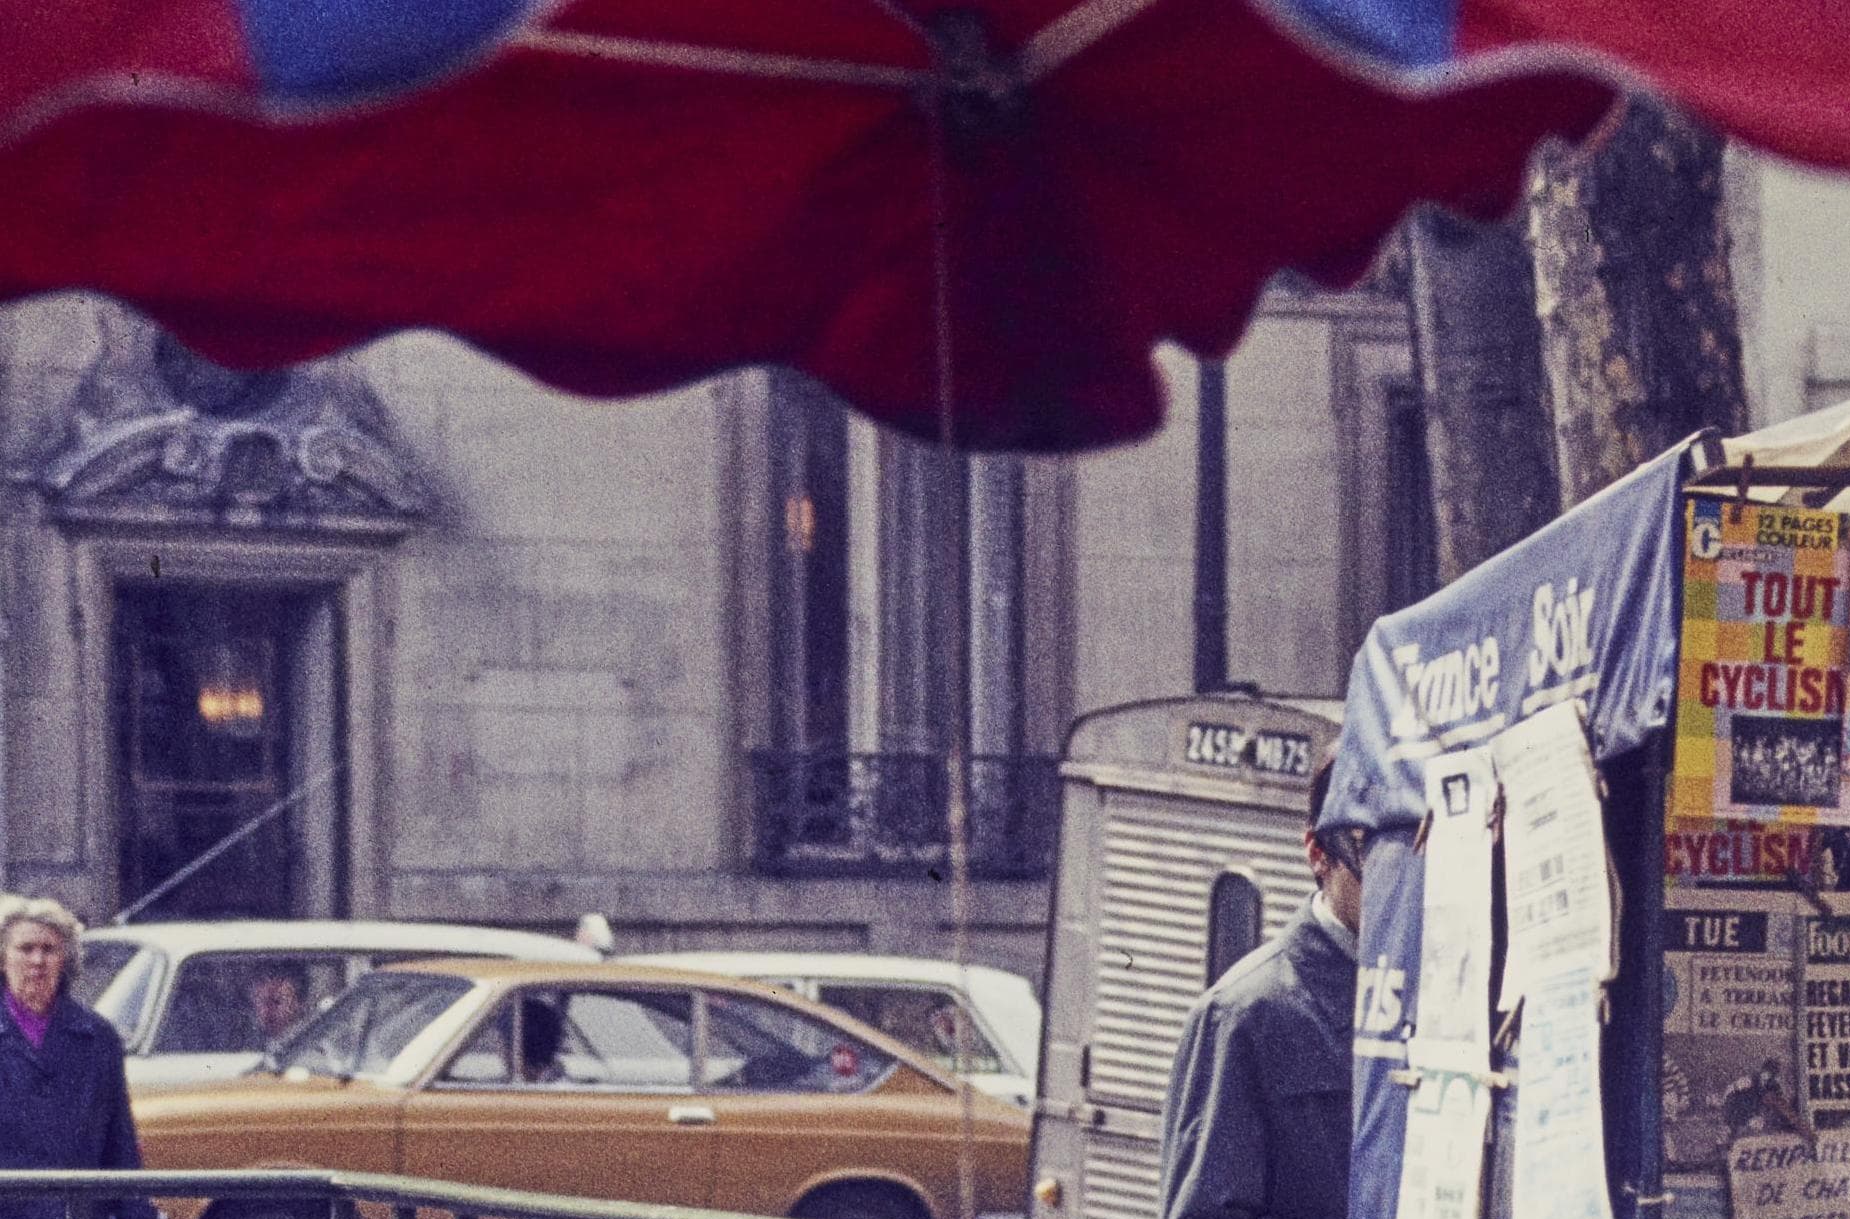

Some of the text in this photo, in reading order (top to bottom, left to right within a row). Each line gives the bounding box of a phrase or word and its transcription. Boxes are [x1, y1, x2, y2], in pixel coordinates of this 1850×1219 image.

[1759, 514, 1834, 533] 12 PAGES
[1756, 531, 1834, 550] COULEUR
[1741, 570, 1841, 622] TOUT
[1764, 620, 1806, 665] LE
[1685, 917, 1741, 947] TUE
[1807, 1041, 1829, 1070] ET
